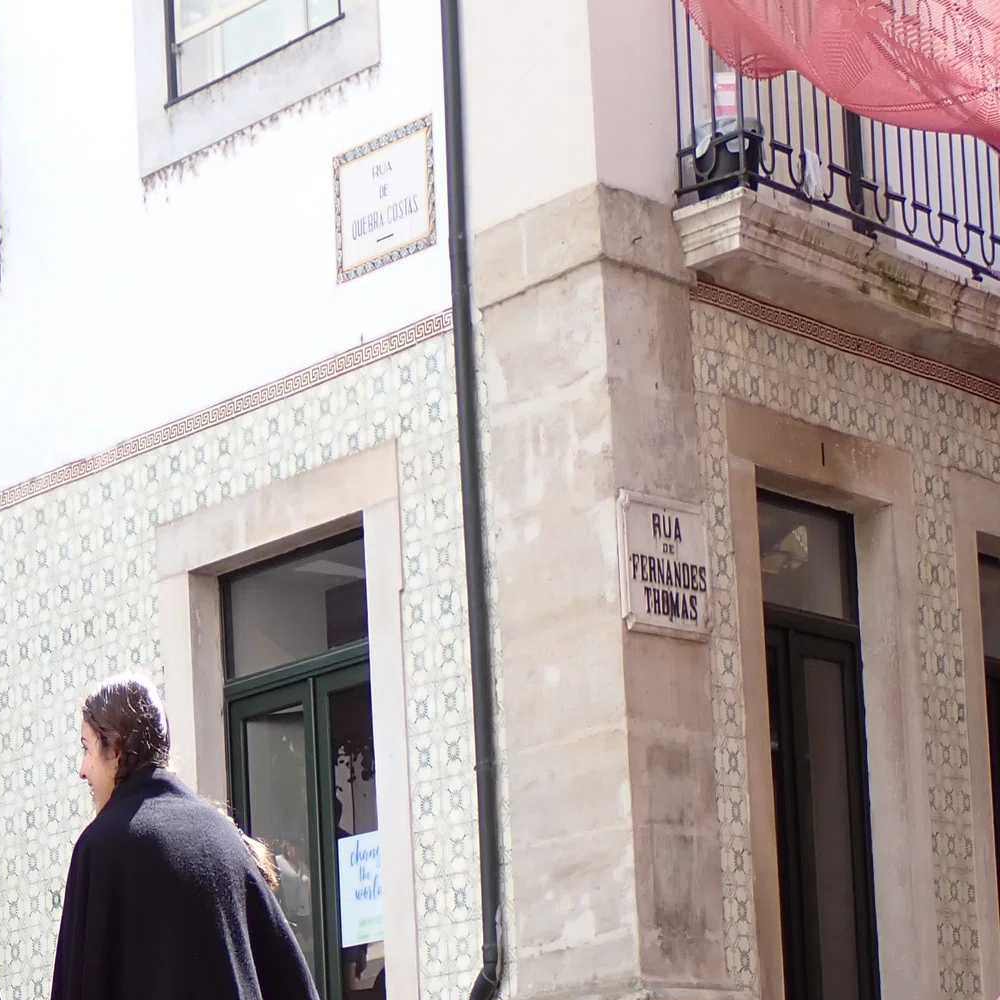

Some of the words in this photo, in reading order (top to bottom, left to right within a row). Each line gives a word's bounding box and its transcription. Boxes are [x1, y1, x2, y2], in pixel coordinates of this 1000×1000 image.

[372, 161, 392, 178] RUA
[379, 185, 388, 199] DE
[352, 211, 384, 240] QUEBRA
[387, 195, 418, 224] COSTAS
[651, 512, 682, 542] RUA
[662, 542, 675, 555] DE
[632, 553, 708, 592] FERNANDES
[644, 586, 699, 621] THOMAS
